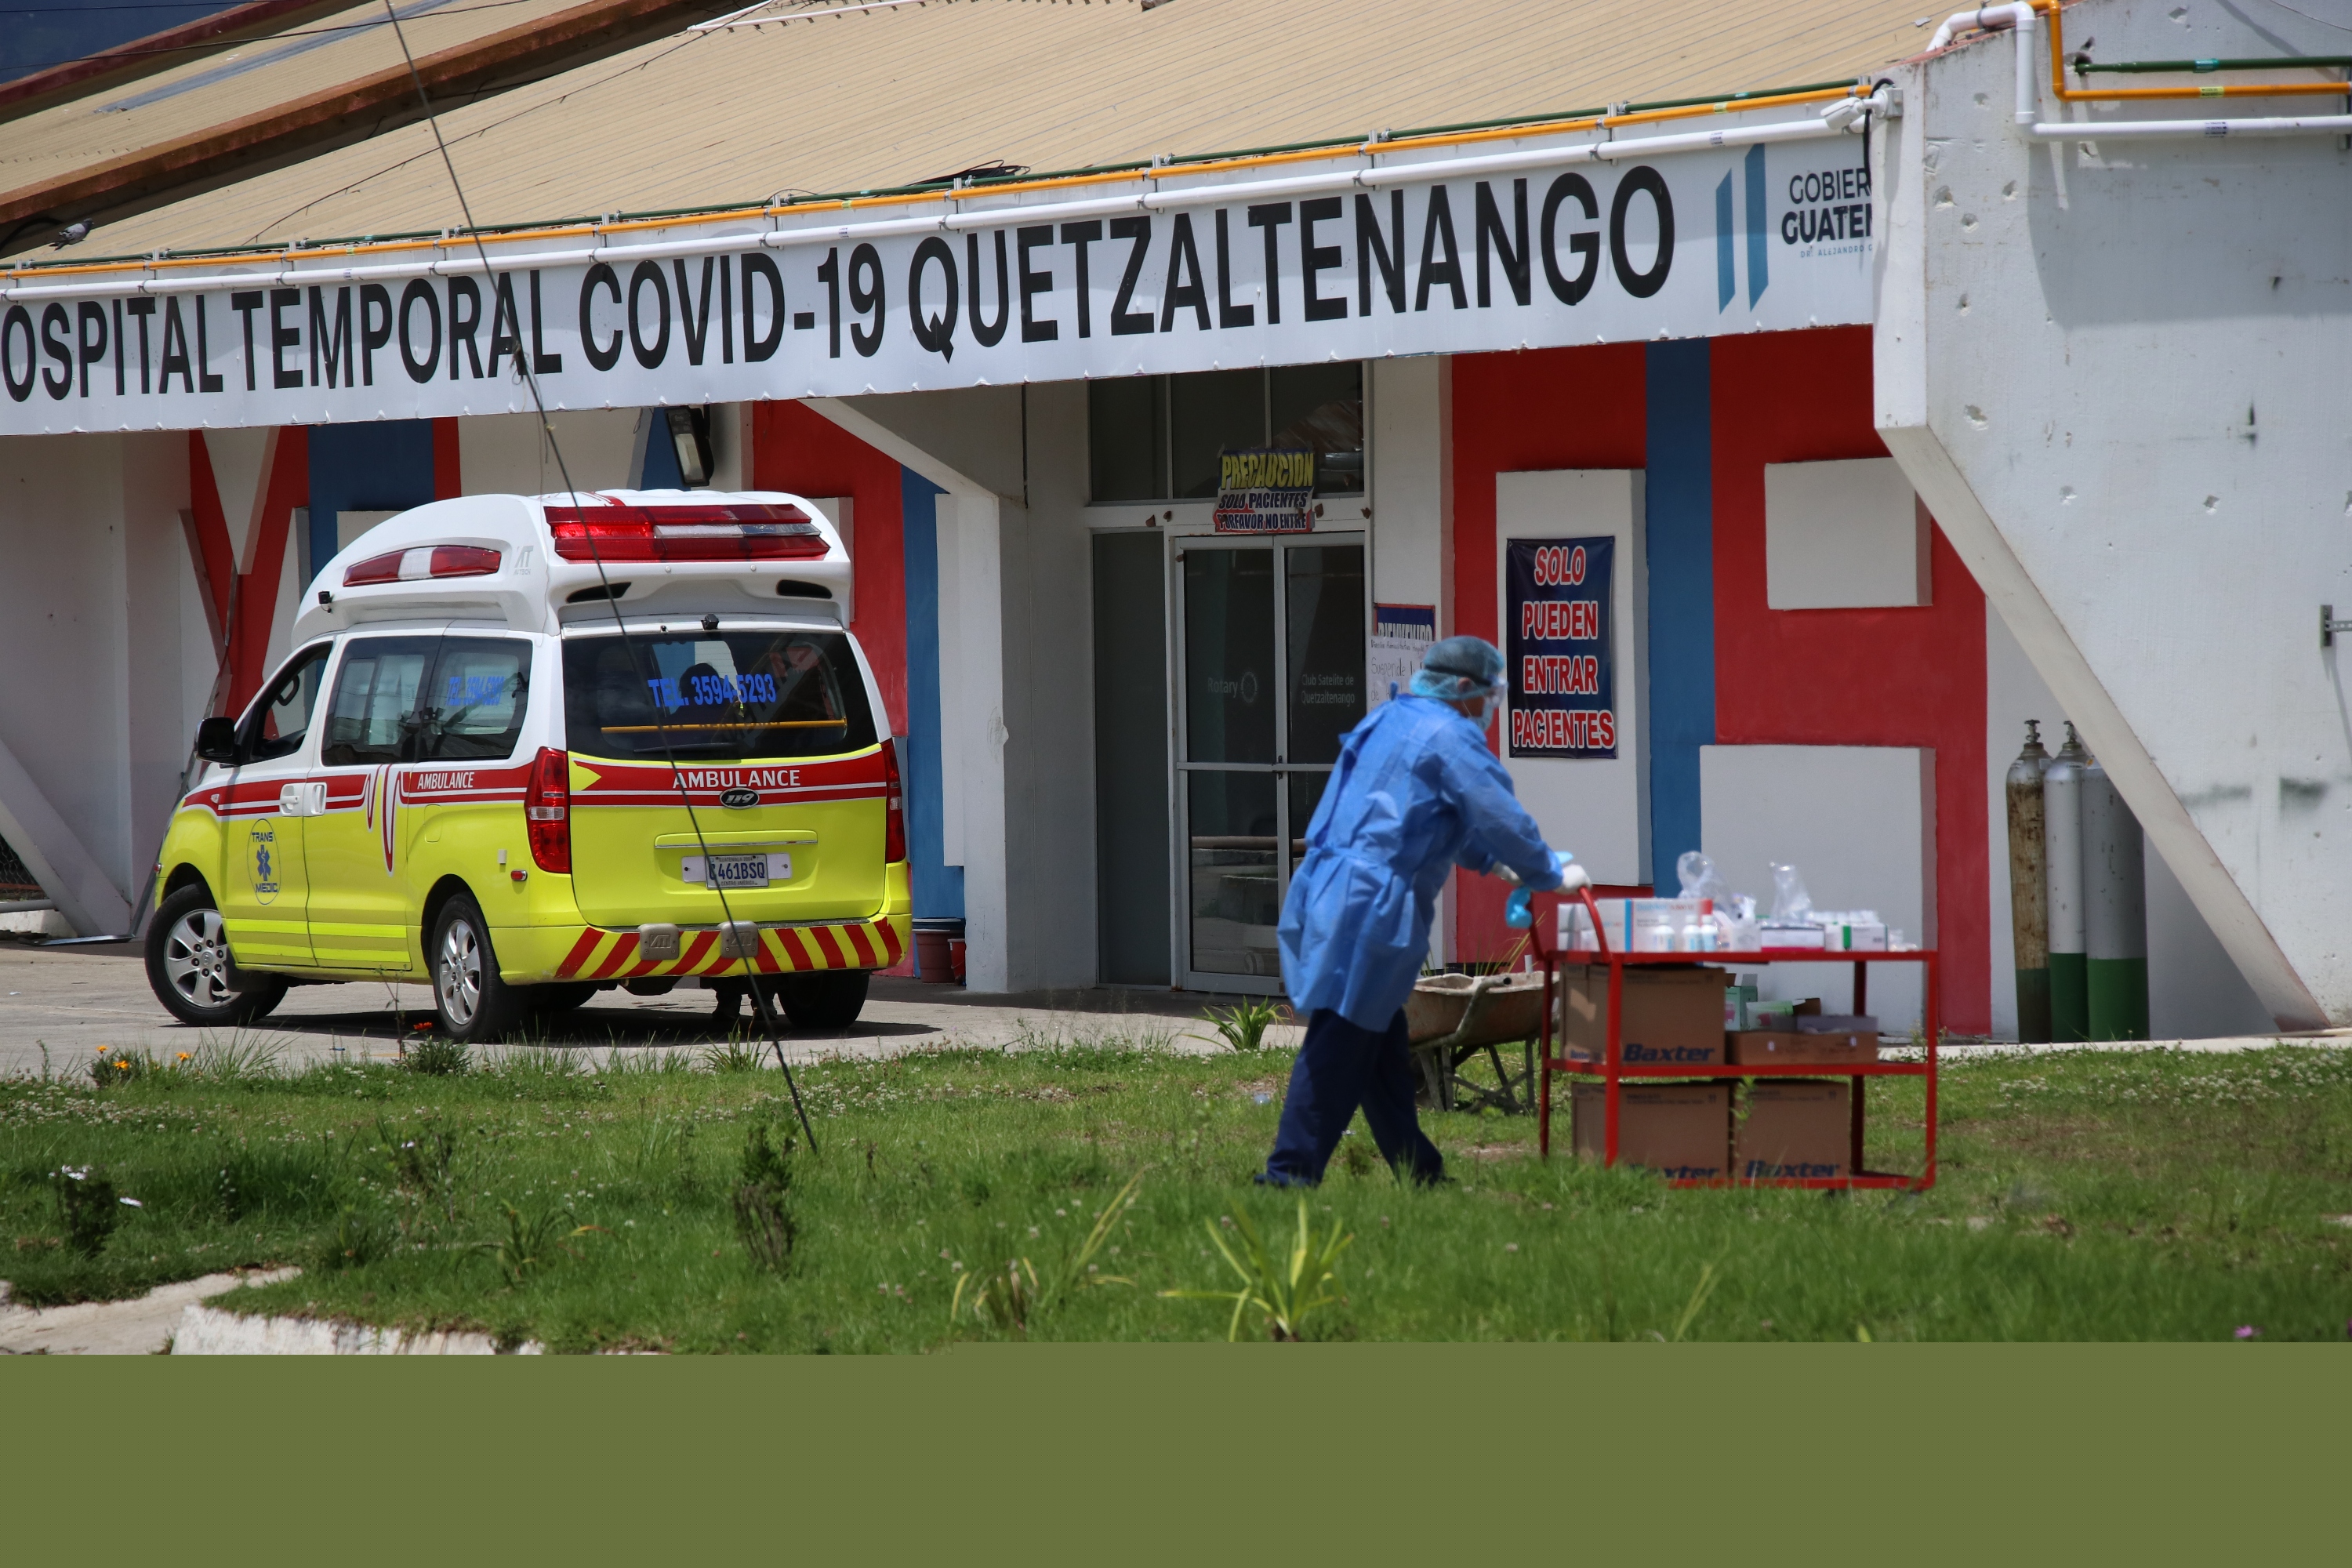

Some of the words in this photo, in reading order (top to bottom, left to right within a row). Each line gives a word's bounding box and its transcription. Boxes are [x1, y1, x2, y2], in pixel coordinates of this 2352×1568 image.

[1818, 245, 1864, 256] ALEJANDRO
[232, 270, 562, 391] TEMPORAL
[579, 243, 886, 372] COVID-19
[909, 165, 1675, 364] QUETZALTENANGO
[1221, 452, 1315, 490] PRECAUCION
[1218, 493, 1246, 510] SOLO
[1248, 492, 1308, 509] PACIENTES
[1265, 514, 1279, 529] NO
[1279, 513, 1306, 529] ENTRE
[1534, 545, 1586, 586] SOLO
[1523, 601, 1598, 640] PUEDEN
[1301, 673, 1316, 686] Club
[1345, 673, 1354, 686] de
[1523, 655, 1598, 695] ENTRAR
[647, 677, 690, 708] TEL.
[691, 673, 778, 706] 3594-5293
[1207, 677, 1239, 699] Rotary
[1301, 690, 1356, 707] Quetzaltenango
[1512, 709, 1615, 749] PACIENTES
[418, 771, 474, 790] AMBULANCE
[673, 769, 800, 789] AMBULANCE
[725, 793, 755, 804] 119
[251, 832, 274, 843] TRANS
[256, 882, 278, 893] MEDIC
[1623, 1043, 1715, 1062] Baxter
[1746, 1160, 1840, 1179] Baxter
